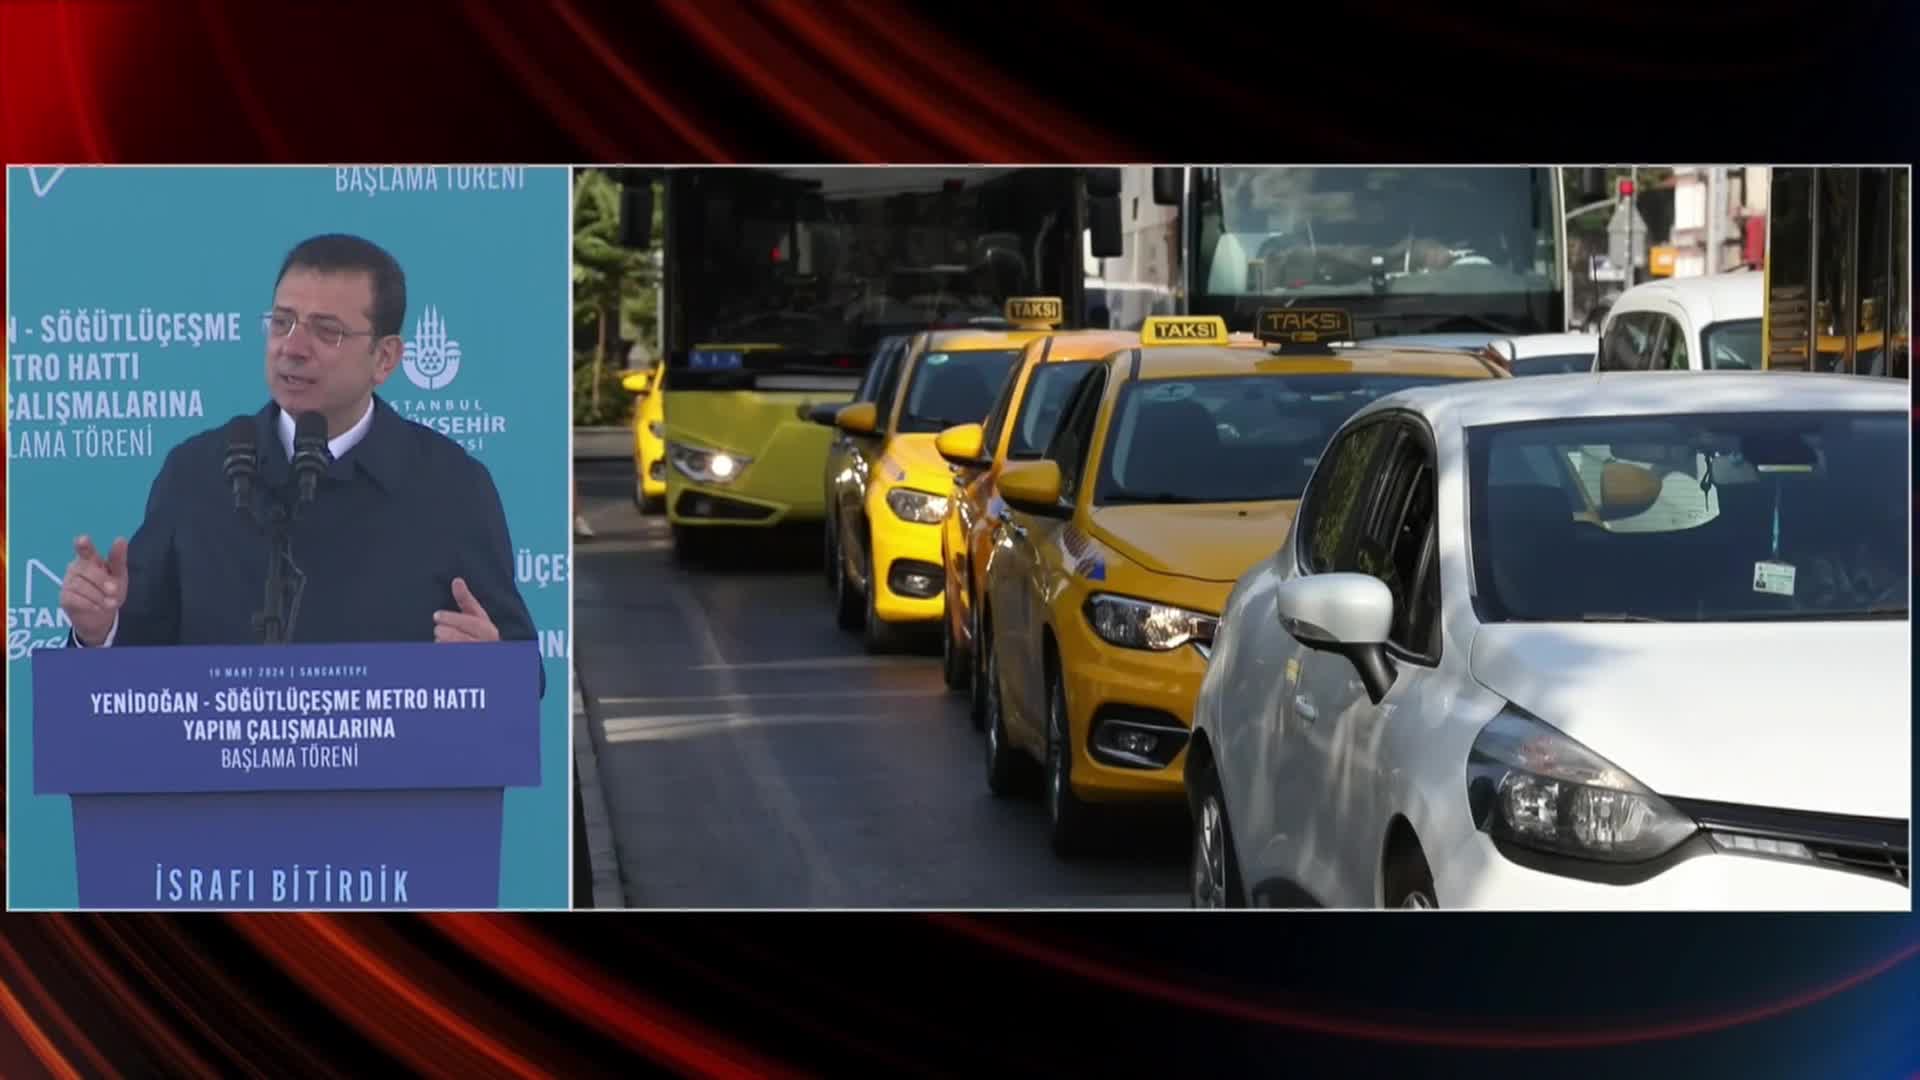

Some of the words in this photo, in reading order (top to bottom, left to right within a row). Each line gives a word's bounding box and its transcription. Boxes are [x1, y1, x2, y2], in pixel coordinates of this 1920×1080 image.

[335, 166, 438, 198] BAŞLAMA
[40, 308, 241, 348] SÖĞÜTLÜÇEŞME
[9, 352, 61, 382] TRO
[68, 351, 140, 382] HATTI
[8, 429, 66, 459] LAMA
[72, 424, 153, 457] TÖRENİ
[91, 688, 198, 714] YENİDOĞAN
[215, 686, 361, 716] SÖĞÜTLÜÇEŞME
[366, 689, 428, 710] METRO
[433, 688, 485, 709] HATTI
[184, 719, 241, 741] YAPIM
[247, 717, 395, 745] ÇALIŞMALARINA
[222, 747, 296, 773] BAŞLAMA
[300, 743, 359, 768] TÖRENİ
[156, 863, 254, 901] İSRAFI
[272, 864, 408, 903] BİTİRDİK
